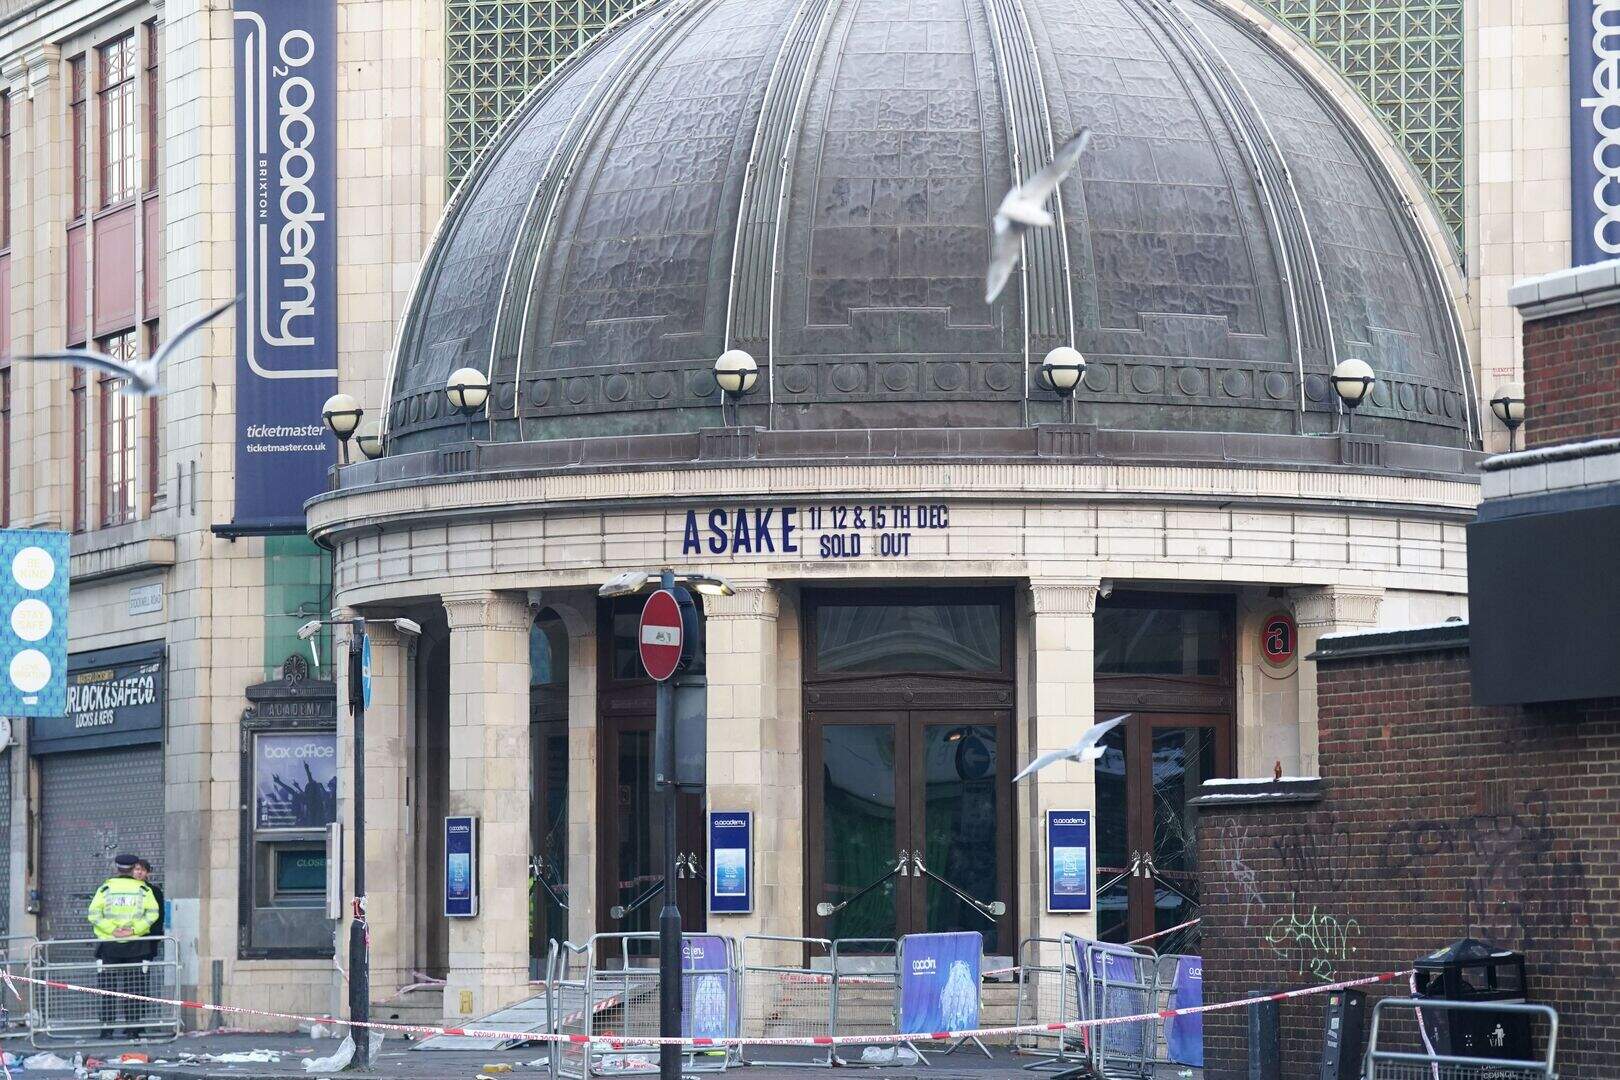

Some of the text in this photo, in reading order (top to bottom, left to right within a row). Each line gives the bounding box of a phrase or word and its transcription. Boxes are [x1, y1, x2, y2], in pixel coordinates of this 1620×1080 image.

[259, 159, 267, 218] BRIXTON
[247, 424, 326, 438] ticketmaster
[247, 442, 326, 452] ticketmaster.co.uk
[682, 507, 798, 554] ASAKE
[830, 506, 848, 529] 12
[854, 505, 867, 528] &
[917, 504, 949, 529] DEC
[819, 533, 911, 558] SOLD OUT
[75, 712, 94, 728] LOCKS
[98, 709, 114, 725] KEYS
[268, 703, 324, 717] ACADEMY
[264, 743, 335, 758] box office
